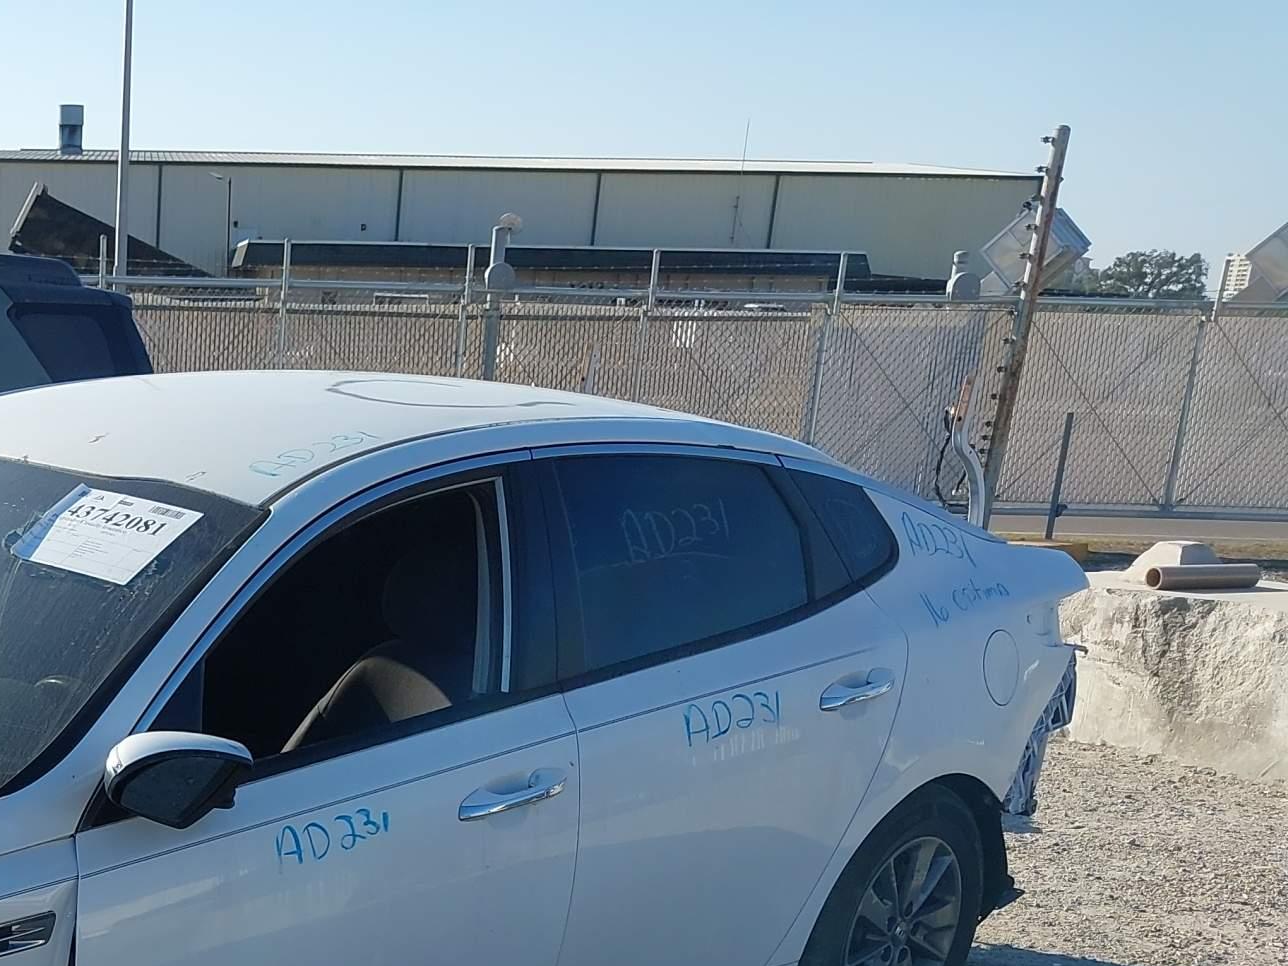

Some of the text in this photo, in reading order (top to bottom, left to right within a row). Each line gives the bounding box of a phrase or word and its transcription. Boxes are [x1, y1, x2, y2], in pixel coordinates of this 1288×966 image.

[249, 431, 381, 477] AD231
[67, 503, 168, 537] 43742081
[622, 498, 730, 566] AD231
[901, 511, 977, 568] AD231
[919, 591, 950, 628] 16
[683, 690, 781, 747] AD231
[275, 808, 390, 866] AD231
